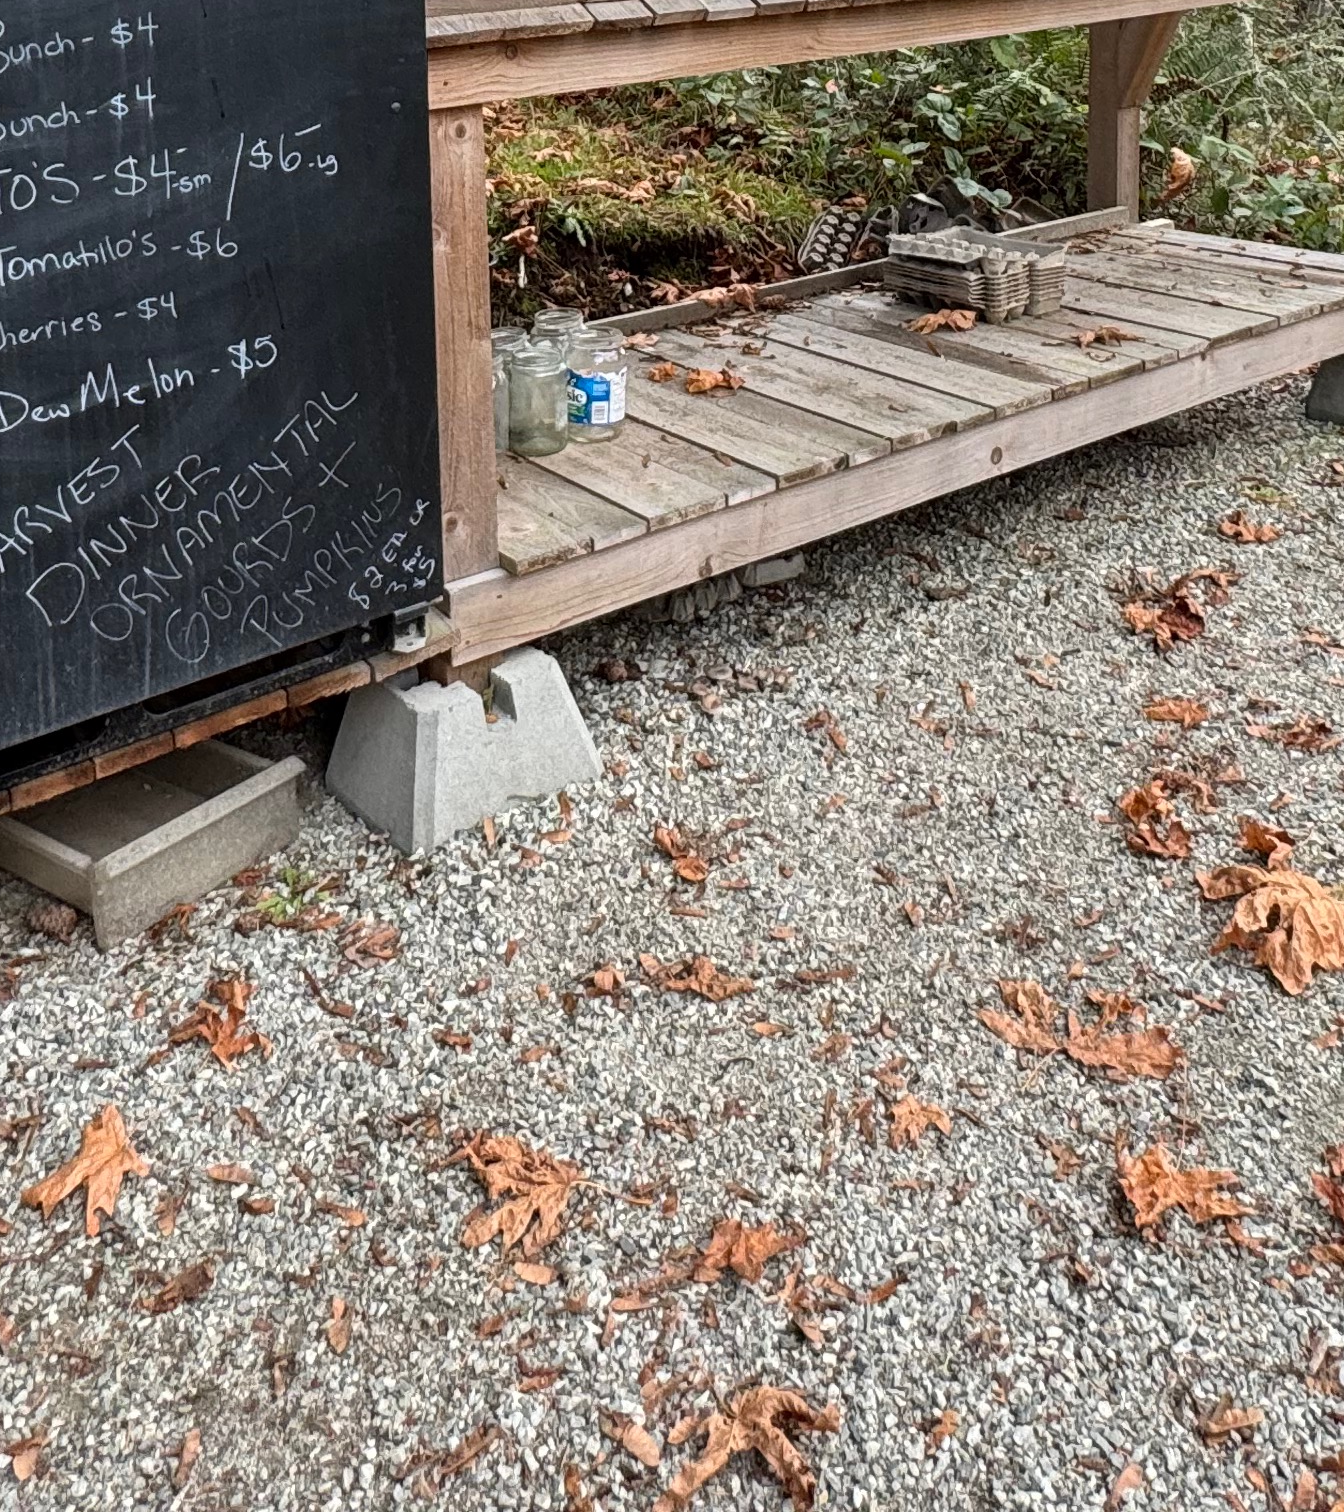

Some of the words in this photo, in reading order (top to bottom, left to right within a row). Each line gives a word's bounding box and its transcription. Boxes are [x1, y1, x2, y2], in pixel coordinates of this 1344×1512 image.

[110, 11, 159, 49] $4
[109, 76, 157, 120] $4
[187, 227, 238, 260] $6
[137, 291, 178, 320] $4
[80, 357, 195, 412] Melon
[227, 335, 278, 378] $5
[25, 453, 221, 627] DINNER
[90, 390, 359, 641] ORNAMENTAL
[165, 495, 316, 664] GOURDS
[240, 482, 402, 648] PUMPKINS
